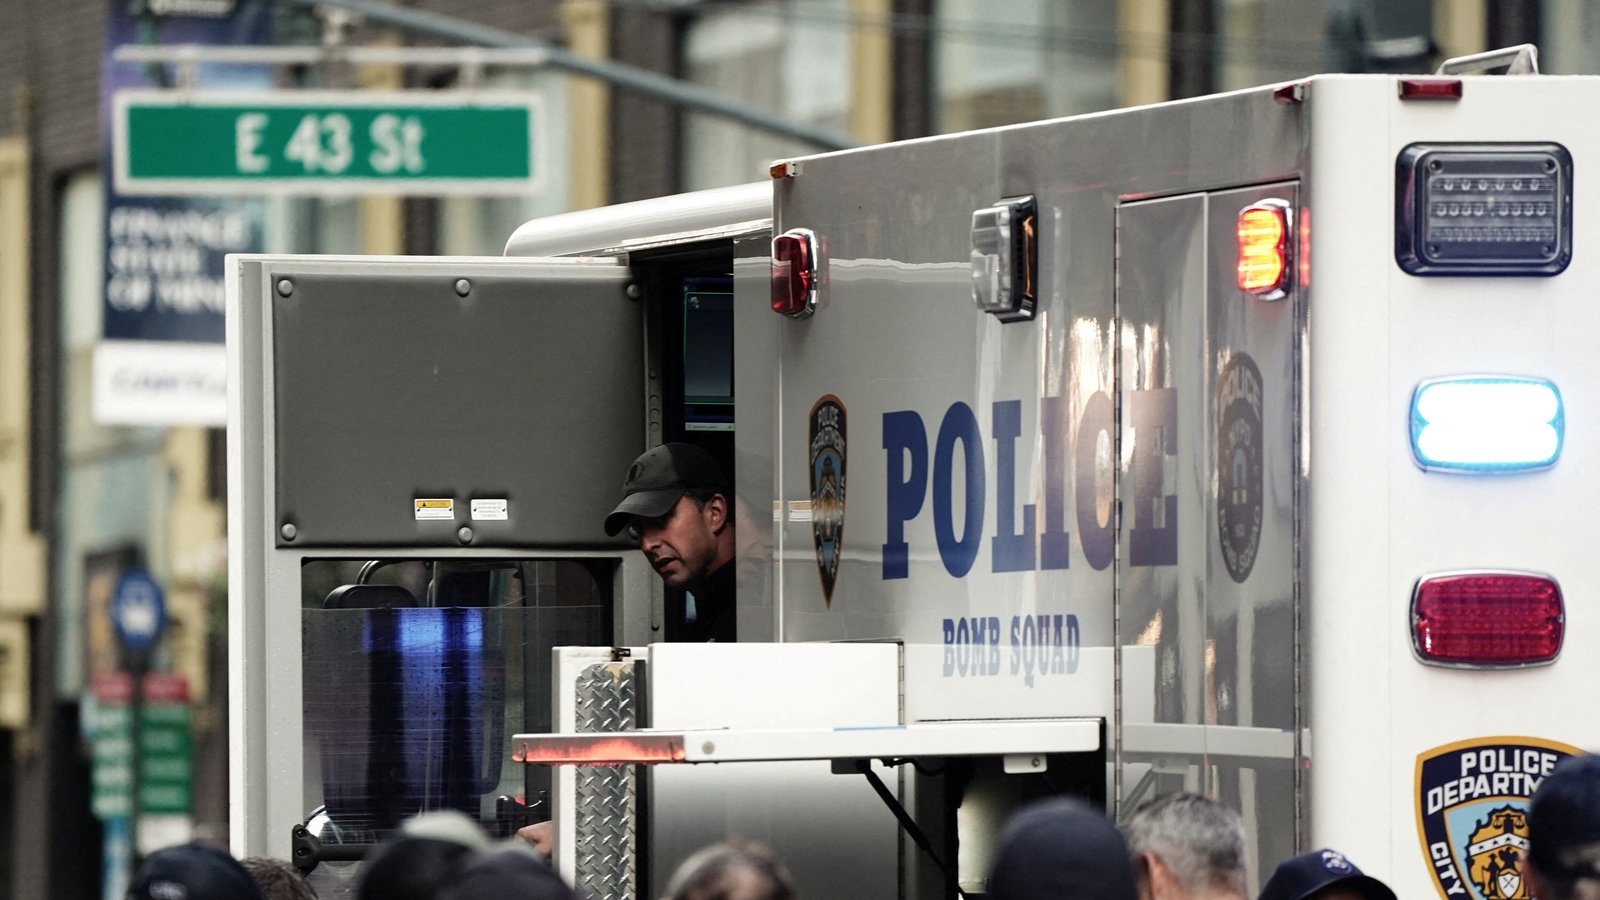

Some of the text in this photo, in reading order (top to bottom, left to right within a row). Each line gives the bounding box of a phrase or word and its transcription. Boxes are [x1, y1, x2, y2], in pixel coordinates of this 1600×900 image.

[235, 112, 425, 174] E 43 St
[882, 388, 1178, 580] POLICE
[943, 613, 1080, 689] BOMB SQUAD
[1461, 749, 1558, 777] POLICE
[1427, 773, 1544, 815] DEPARTM
[1430, 841, 1465, 896] CITY
